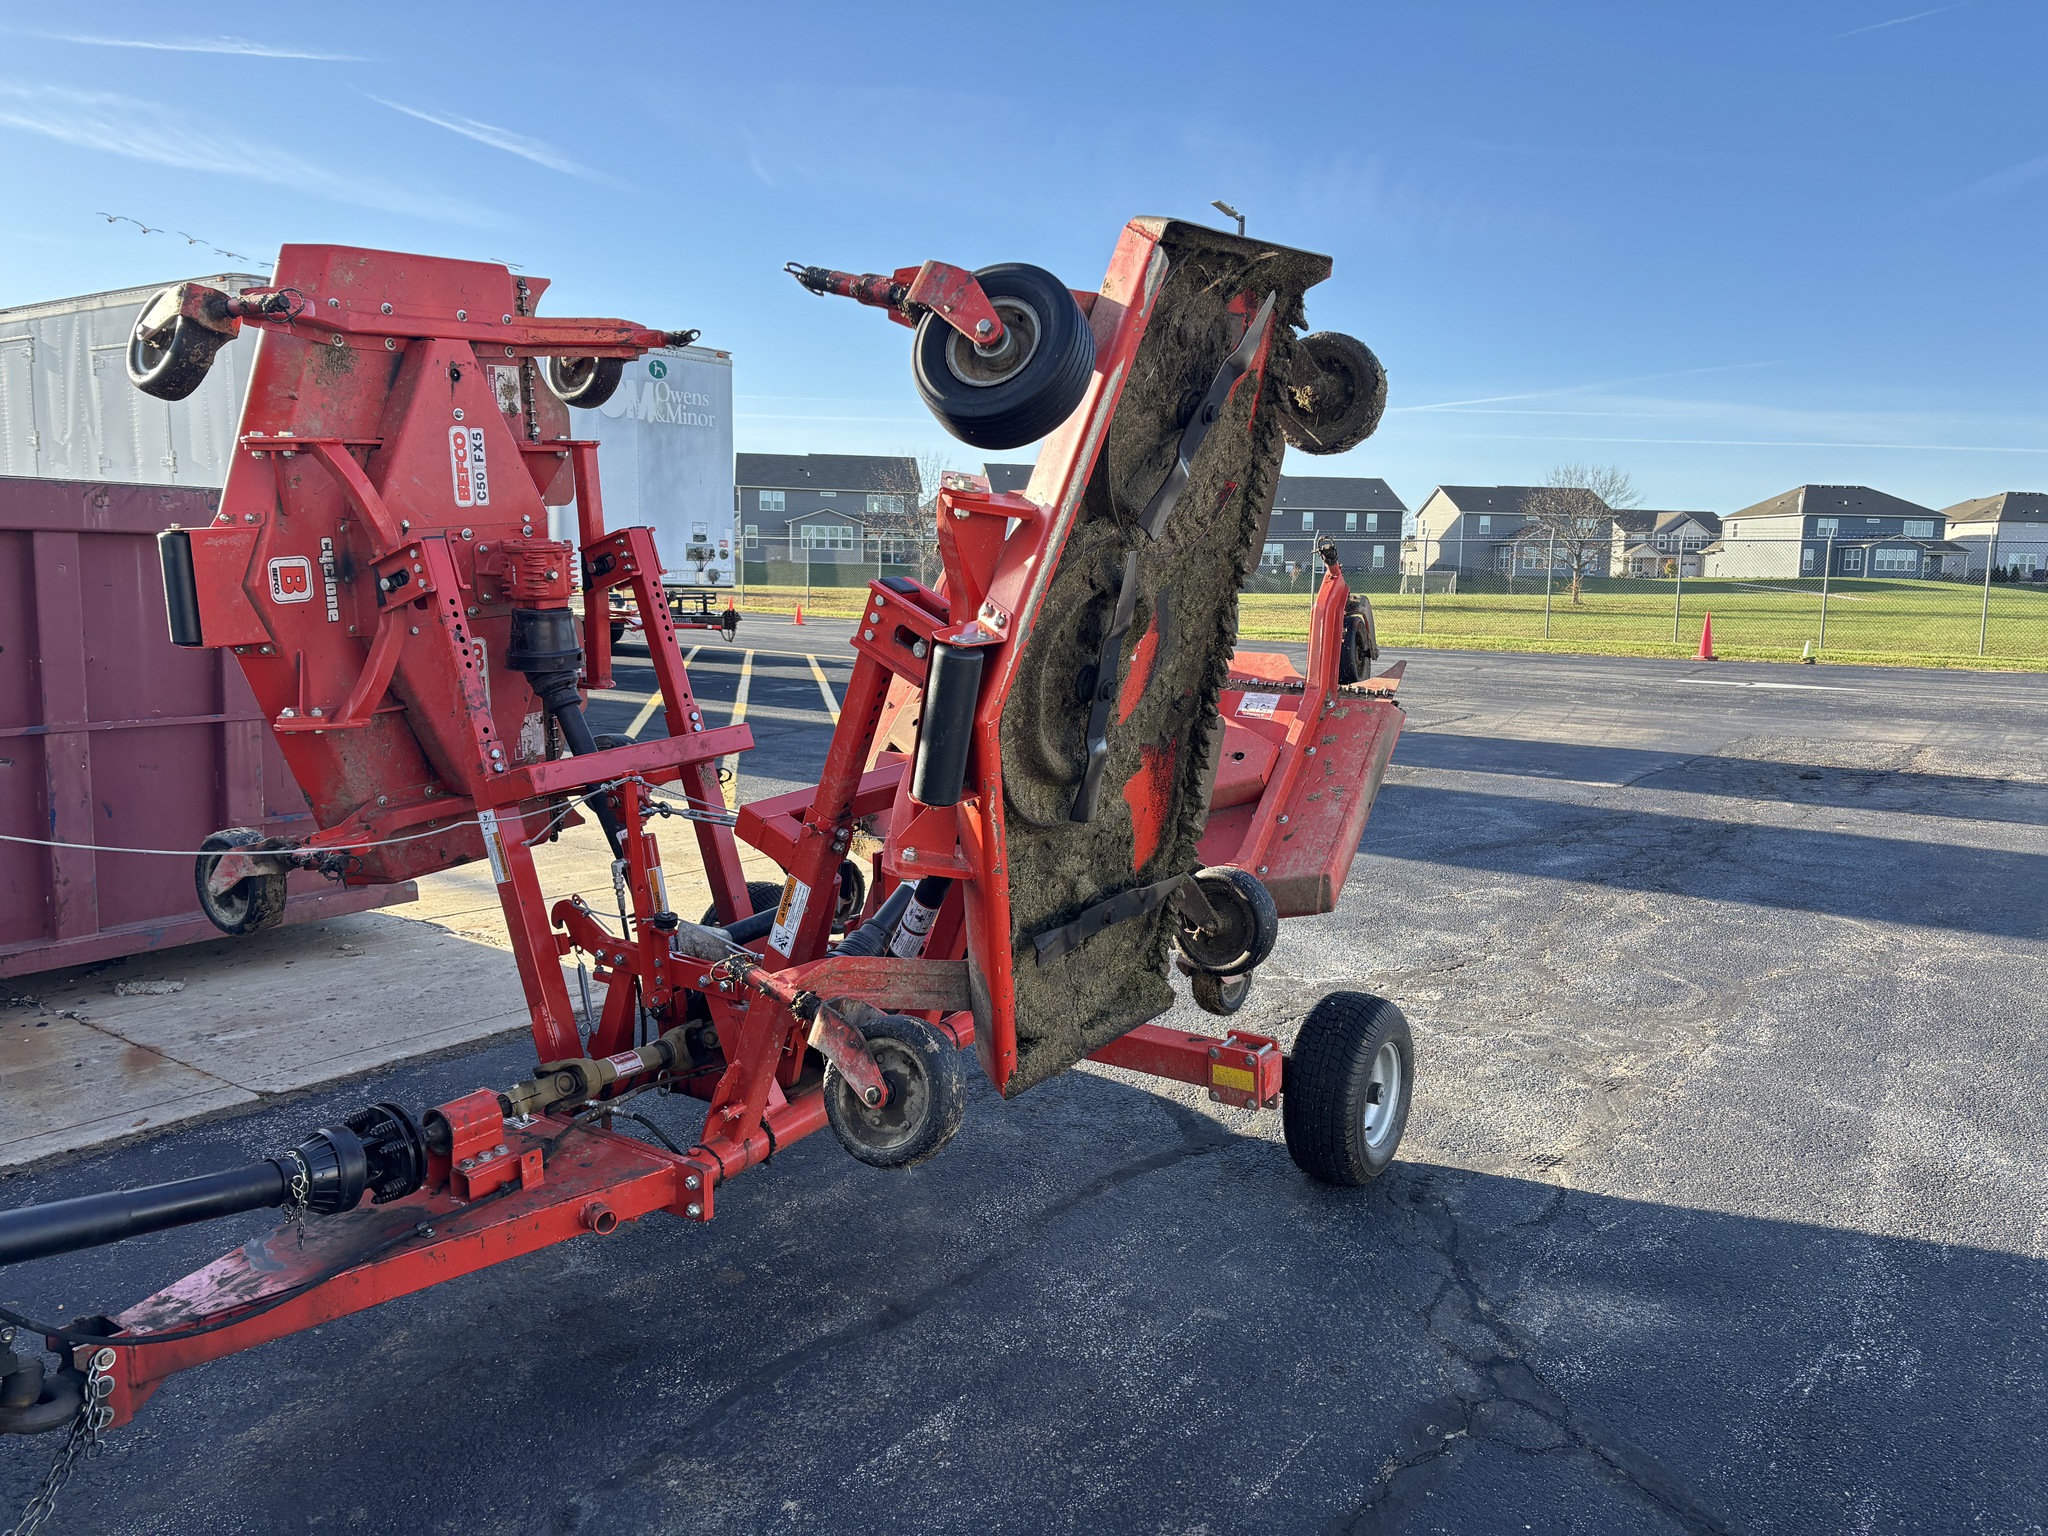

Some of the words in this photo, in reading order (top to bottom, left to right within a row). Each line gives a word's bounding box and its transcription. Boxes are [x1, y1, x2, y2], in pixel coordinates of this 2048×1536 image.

[655, 381, 709, 407] Owens
[472, 432, 484, 463] FX5
[453, 431, 471, 501] BEFCO
[477, 472, 487, 501] C50
[271, 567, 280, 595] BEFCO
[279, 566, 307, 594] B
[318, 537, 339, 623] cyclone
[783, 884, 794, 912] WARNING
